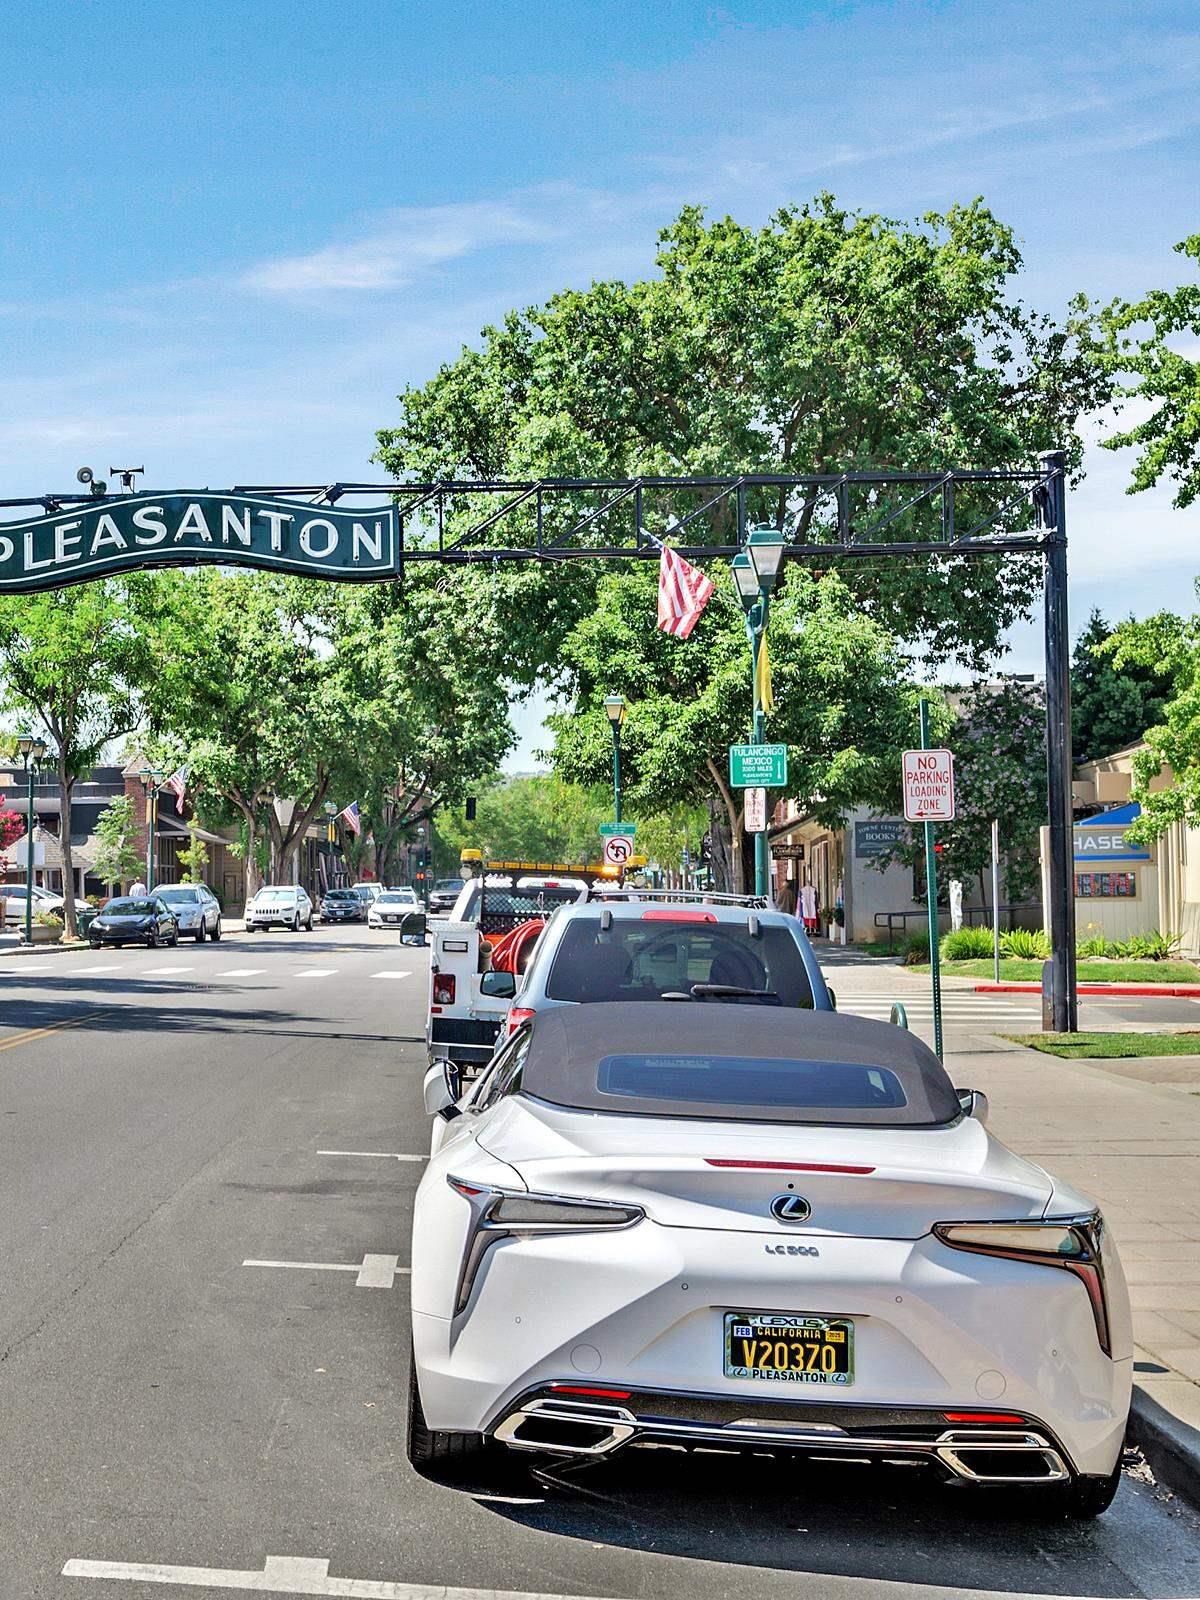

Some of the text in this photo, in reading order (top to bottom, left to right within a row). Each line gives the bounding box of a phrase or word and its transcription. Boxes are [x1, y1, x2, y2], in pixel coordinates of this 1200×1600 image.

[733, 747, 784, 757] TULANCINGO
[741, 757, 773, 765] MEXICO
[917, 756, 937, 770] NO
[906, 771, 949, 785] PARKING
[910, 786, 947, 797] LOADING
[917, 799, 940, 810] ZONE
[1073, 836, 1125, 850] HASE
[765, 1245, 786, 1255] LC
[760, 1317, 820, 1328] LEXUS
[736, 1327, 751, 1336] FEB
[757, 1327, 821, 1339] CALIFORNIA
[752, 1369, 827, 1383] PLEASANTON
